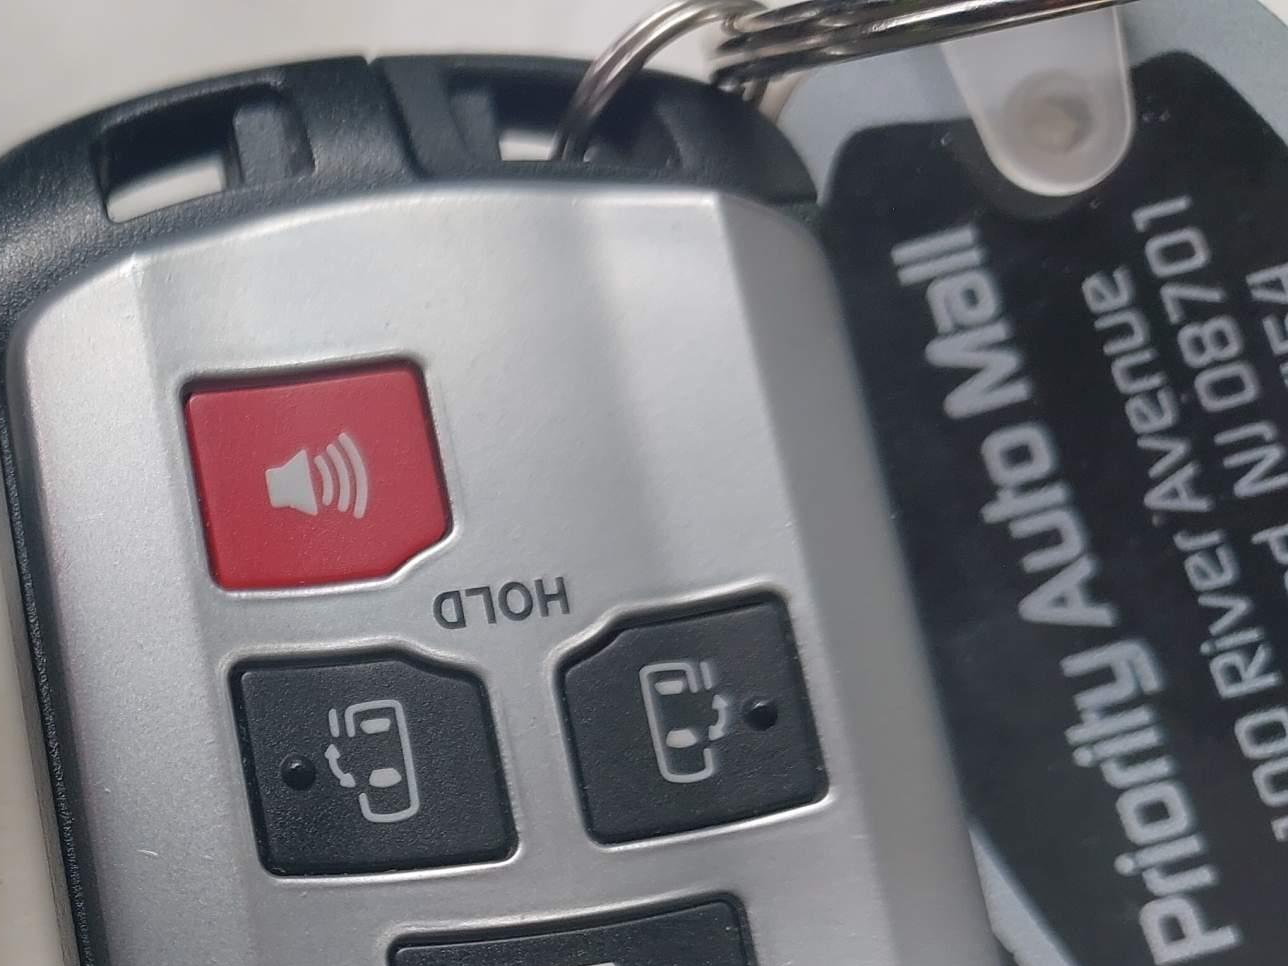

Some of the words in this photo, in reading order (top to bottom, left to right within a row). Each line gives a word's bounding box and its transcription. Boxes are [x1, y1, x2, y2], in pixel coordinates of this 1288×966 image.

[892, 224, 1034, 420] Mall
[1081, 264, 1214, 513] Avenue
[1132, 196, 1261, 412] 08701
[980, 422, 1117, 628] Auto
[1214, 420, 1288, 498] NJ
[432, 576, 570, 630] HOLD
[1174, 528, 1283, 698] River
[1060, 638, 1241, 966] Priority
[1234, 707, 1288, 841] 00
